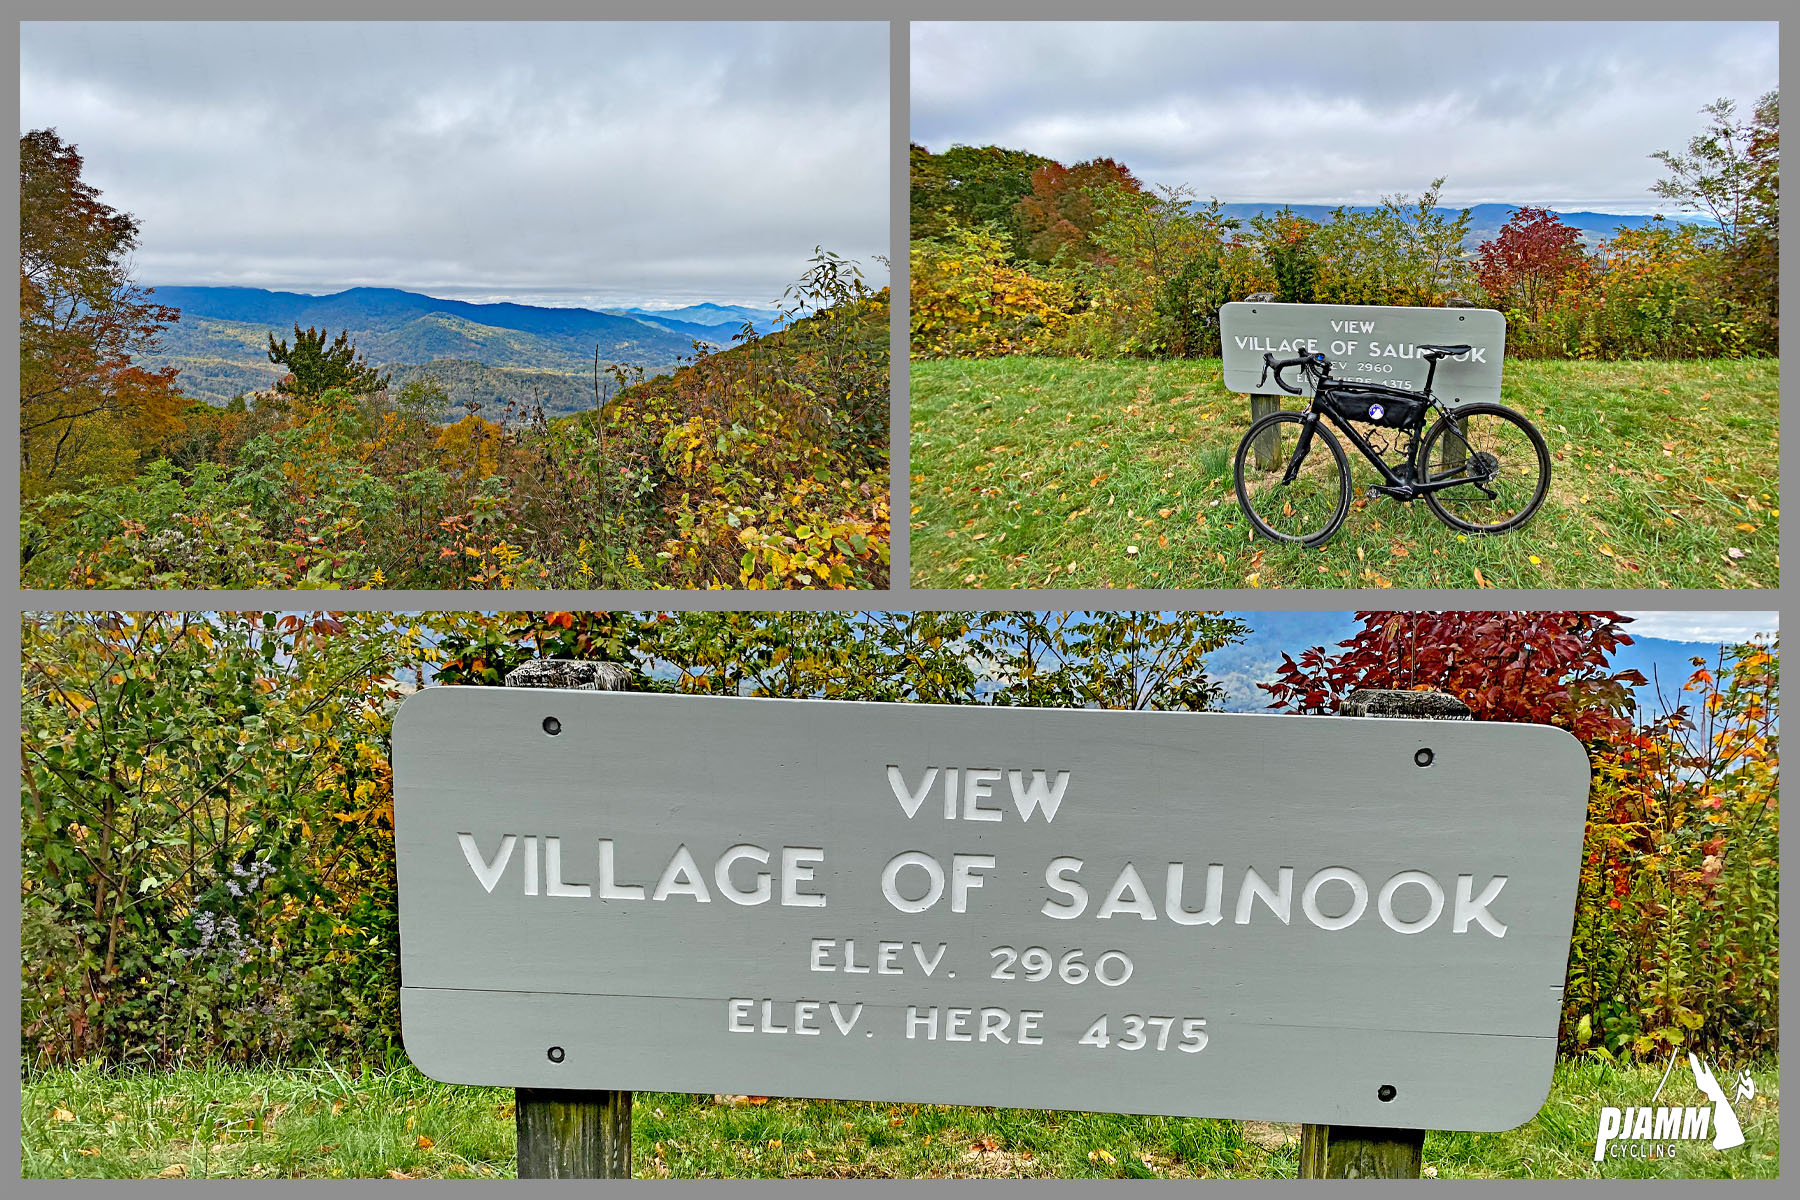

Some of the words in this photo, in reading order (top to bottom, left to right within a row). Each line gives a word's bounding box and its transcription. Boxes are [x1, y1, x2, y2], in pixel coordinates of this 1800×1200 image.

[1234, 335, 1318, 353] VILLAGE
[1331, 340, 1358, 355] OF
[1331, 320, 1375, 334] VIEW
[1357, 362, 1393, 373] 2960
[887, 766, 1071, 824] VIEW
[458, 832, 827, 908] VILLAGE
[881, 853, 997, 914] OF
[1041, 855, 1508, 938] SAUNOOK
[810, 939, 956, 978] ELEV.
[989, 947, 1134, 987] 2960
[728, 998, 873, 1038] ELEV.
[906, 1006, 1044, 1045] HERE
[1078, 1015, 1209, 1054] 4375
